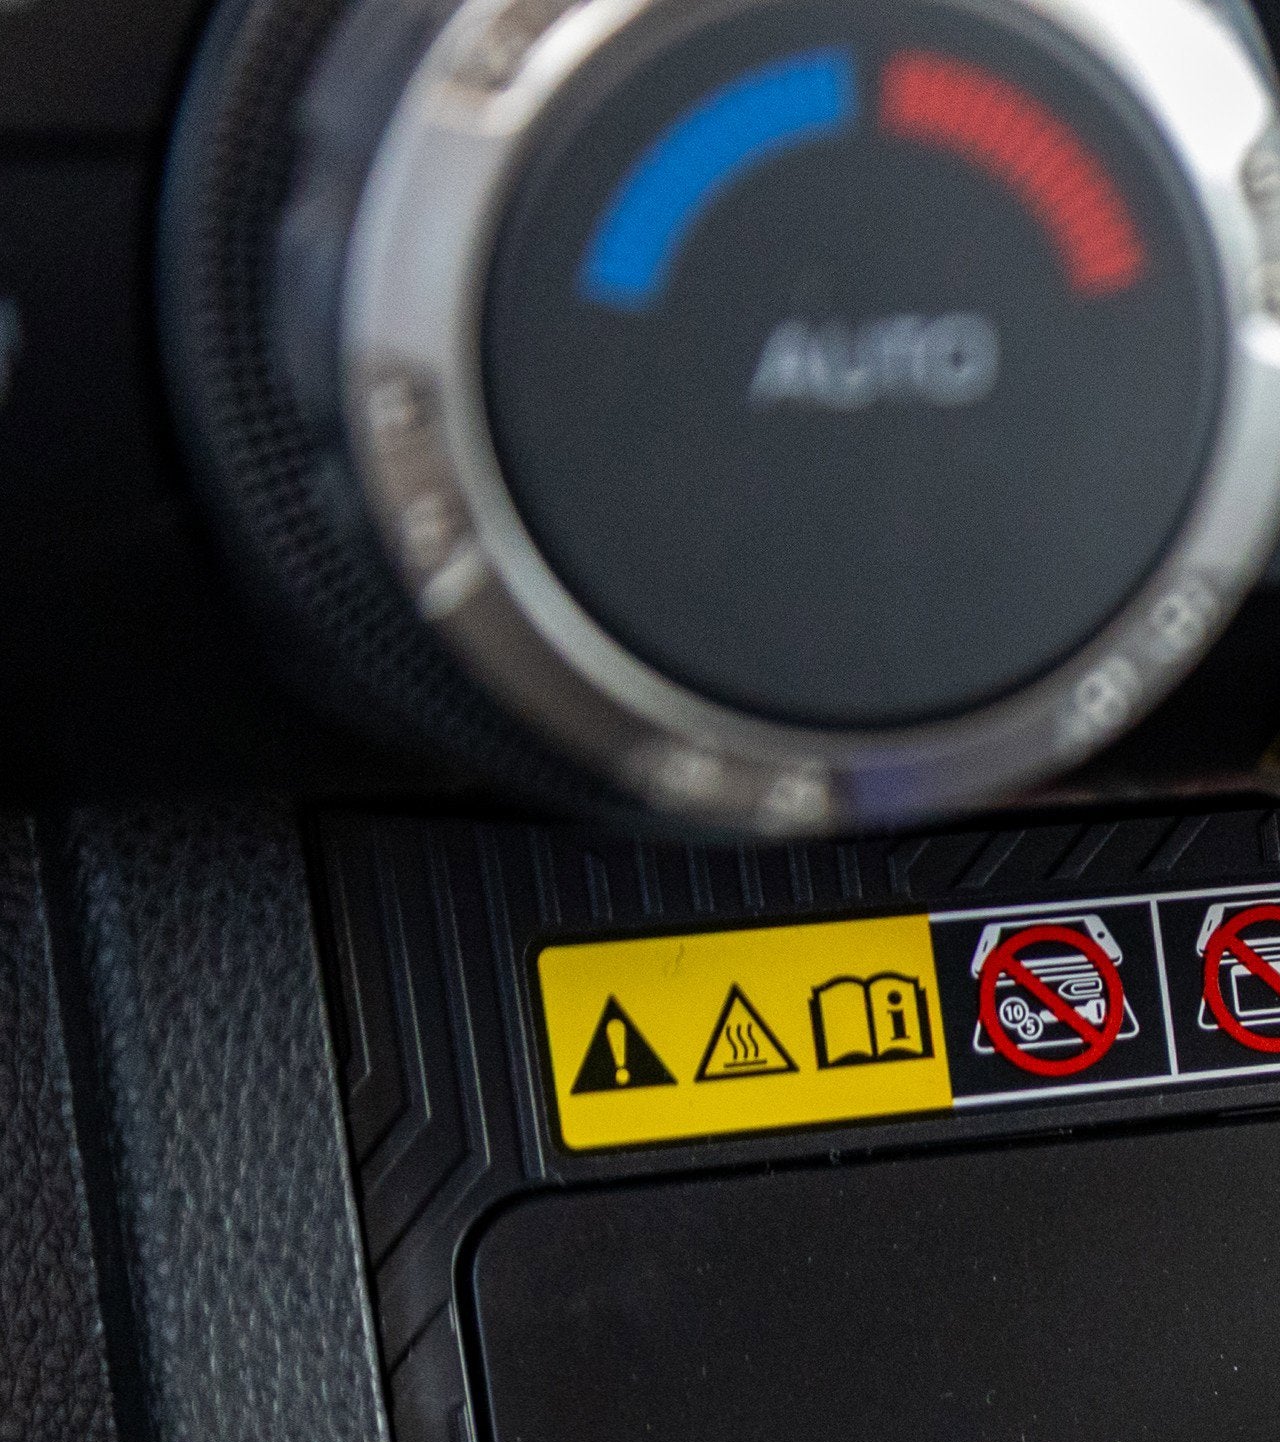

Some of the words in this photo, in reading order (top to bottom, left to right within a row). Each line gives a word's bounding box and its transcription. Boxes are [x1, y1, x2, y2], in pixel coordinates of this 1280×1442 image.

[750, 314, 998, 406] AUTO
[1005, 1003, 1023, 1020] 10
[1025, 1019, 1037, 1035] 5
